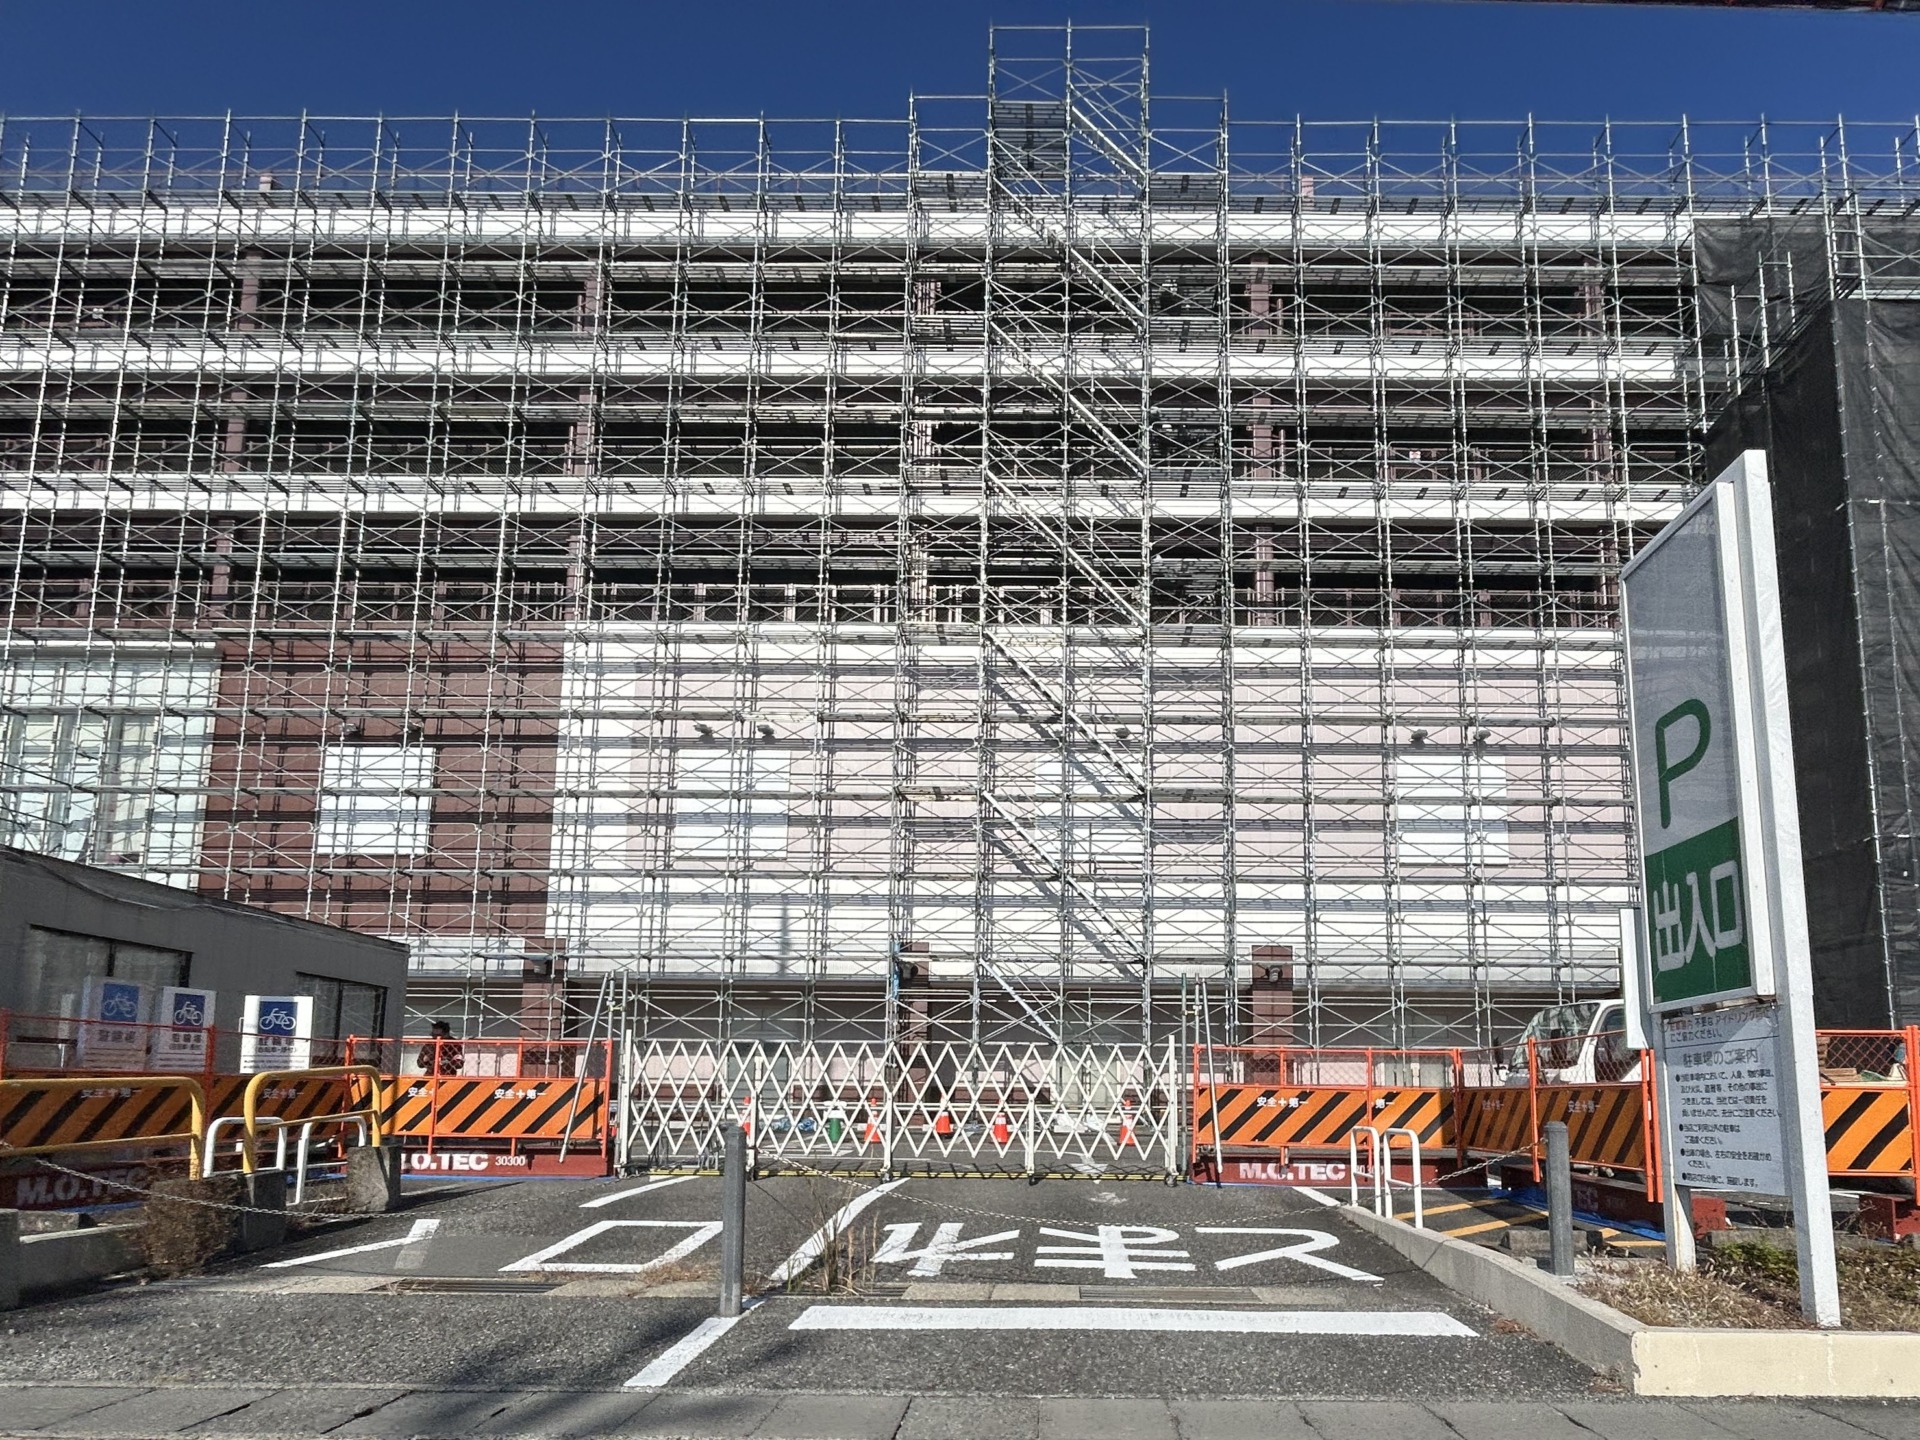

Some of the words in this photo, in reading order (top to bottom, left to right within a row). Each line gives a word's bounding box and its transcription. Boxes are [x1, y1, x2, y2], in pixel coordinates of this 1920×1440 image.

[1655, 698, 1711, 829] P
[1653, 860, 1743, 972] 出入口
[1683, 1048, 1758, 1068] 駐車場のご案内
[495, 1156, 526, 1167] 30300
